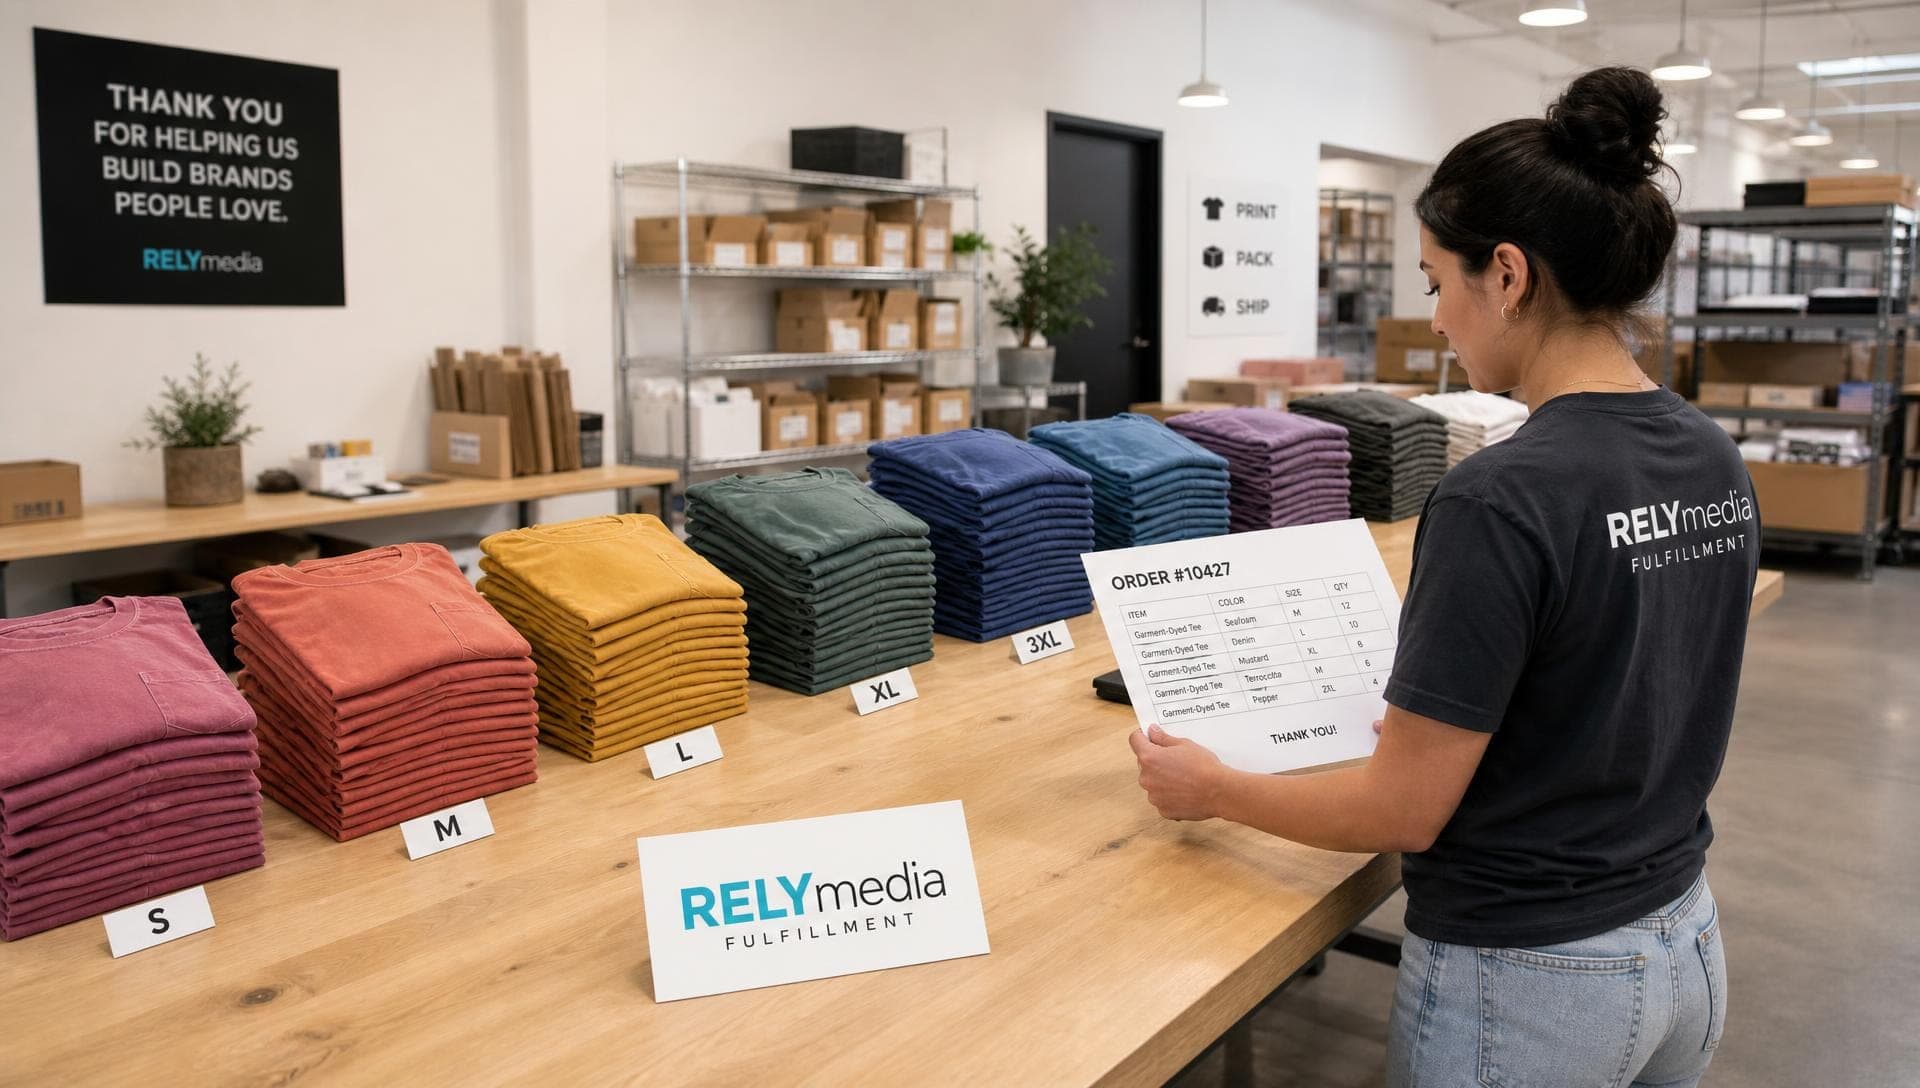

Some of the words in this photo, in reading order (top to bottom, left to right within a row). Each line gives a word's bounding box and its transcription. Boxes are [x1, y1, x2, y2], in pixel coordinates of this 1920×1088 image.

[107, 83, 215, 120] THANK
[223, 96, 283, 126] YOU
[94, 120, 148, 147] FOR
[155, 126, 261, 157] HELPING
[267, 136, 299, 160] US
[102, 155, 182, 184] BUILD
[189, 162, 293, 191] BRANDS
[115, 192, 213, 218] PEOPLE
[219, 197, 288, 223] LOVE.
[1236, 203, 1277, 219] PRINT
[143, 249, 263, 273] RELYmedia
[1236, 251, 1273, 266] PACK
[1236, 299, 1270, 315] SHIP
[1606, 490, 1752, 548] RELYmedia
[1632, 534, 1745, 573] FULFILLMENT
[1111, 570, 1171, 590] ORDER
[1174, 562, 1230, 582] #10427
[1128, 610, 1147, 619] ITEM
[1218, 597, 1245, 607] COLOR
[1285, 589, 1302, 598] SIZE
[1334, 583, 1348, 591] QTY
[1134, 625, 1187, 639] Garment-Dyed
[1188, 624, 1202, 632] Tee
[1225, 616, 1256, 627] Seafoam
[1293, 609, 1301, 617] M
[1341, 602, 1351, 610] 12
[1026, 630, 1062, 654] 3XL
[1141, 645, 1194, 659] Garment-Dyed
[1195, 643, 1209, 651] Tee
[1232, 636, 1256, 646] Denim
[1349, 621, 1358, 629] 10
[1148, 665, 1201, 679] Garment-Dyed
[1202, 663, 1216, 671] Tee
[1239, 654, 1269, 665] Mustard
[1155, 684, 1208, 698] Garment-Dyed
[1315, 666, 1323, 674] M
[870, 680, 900, 703] XL
[1162, 704, 1215, 718] Garment-Dyed
[1216, 701, 1230, 709] Tee
[1252, 694, 1278, 704] Pepper
[1322, 685, 1336, 694] 2XL
[1270, 730, 1309, 745] THANK
[1310, 725, 1338, 738] YOU!
[676, 742, 693, 762] L
[433, 815, 462, 842] M
[680, 861, 946, 930] RELYmedia
[148, 907, 170, 934] S
[725, 912, 914, 950] FULFILLMENT
